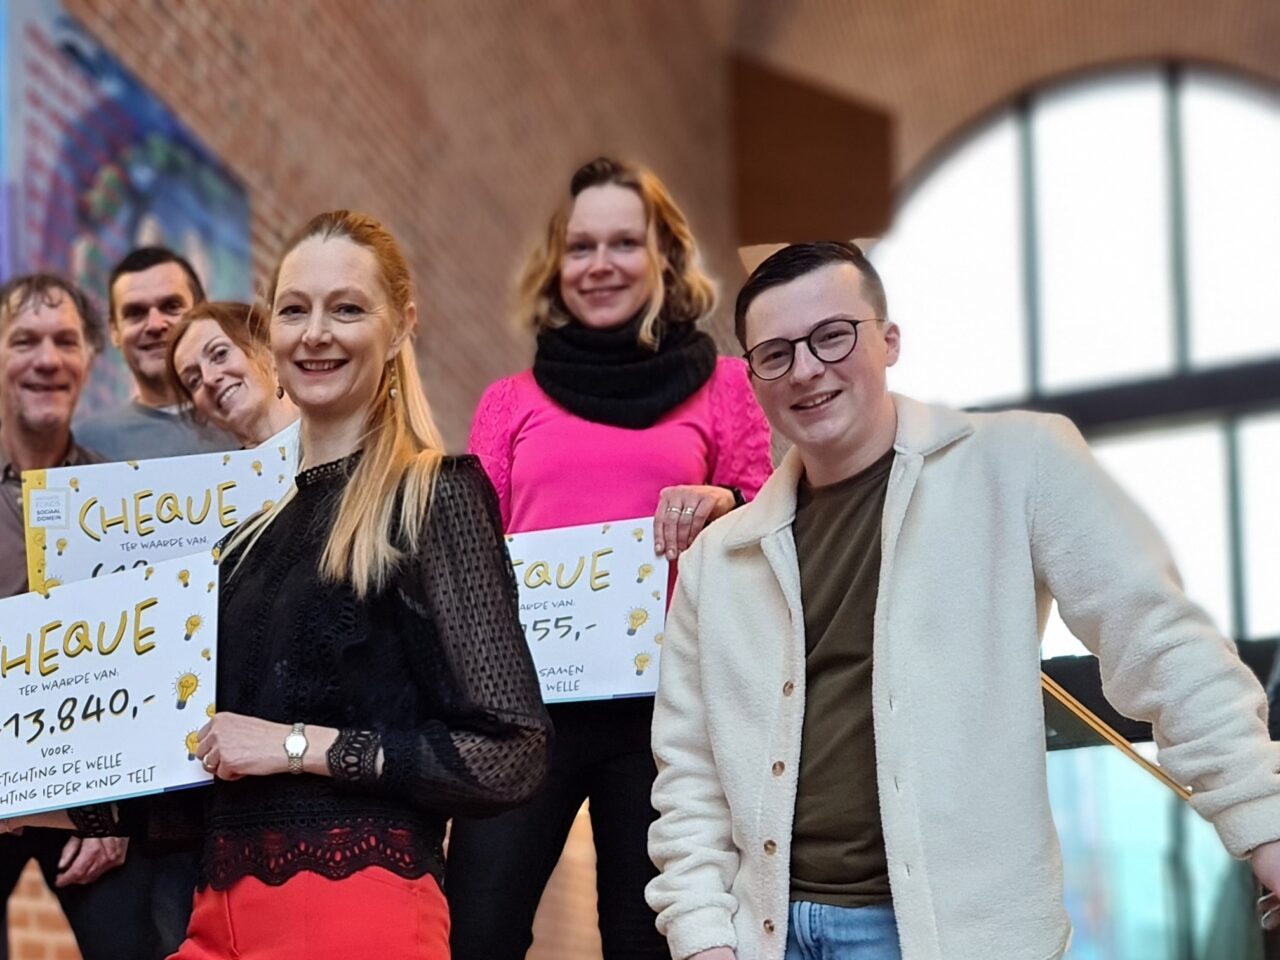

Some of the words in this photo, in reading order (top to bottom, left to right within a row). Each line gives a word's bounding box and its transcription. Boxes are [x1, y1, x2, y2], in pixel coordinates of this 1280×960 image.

[79, 480, 238, 542] CHEQUE
[120, 542, 137, 552] TER
[141, 537, 183, 550] WAARDE
[539, 664, 584, 677] SAMEN
[18, 684, 38, 696] TER
[41, 674, 91, 691] WAARDE
[546, 680, 580, 692] WELLE
[41, 744, 75, 759] VOOR:
[62, 761, 83, 776] DE
[86, 752, 123, 770] WELLE
[42, 781, 82, 799] IEDER
[86, 773, 122, 790] KIND
[127, 765, 158, 785] TELT
